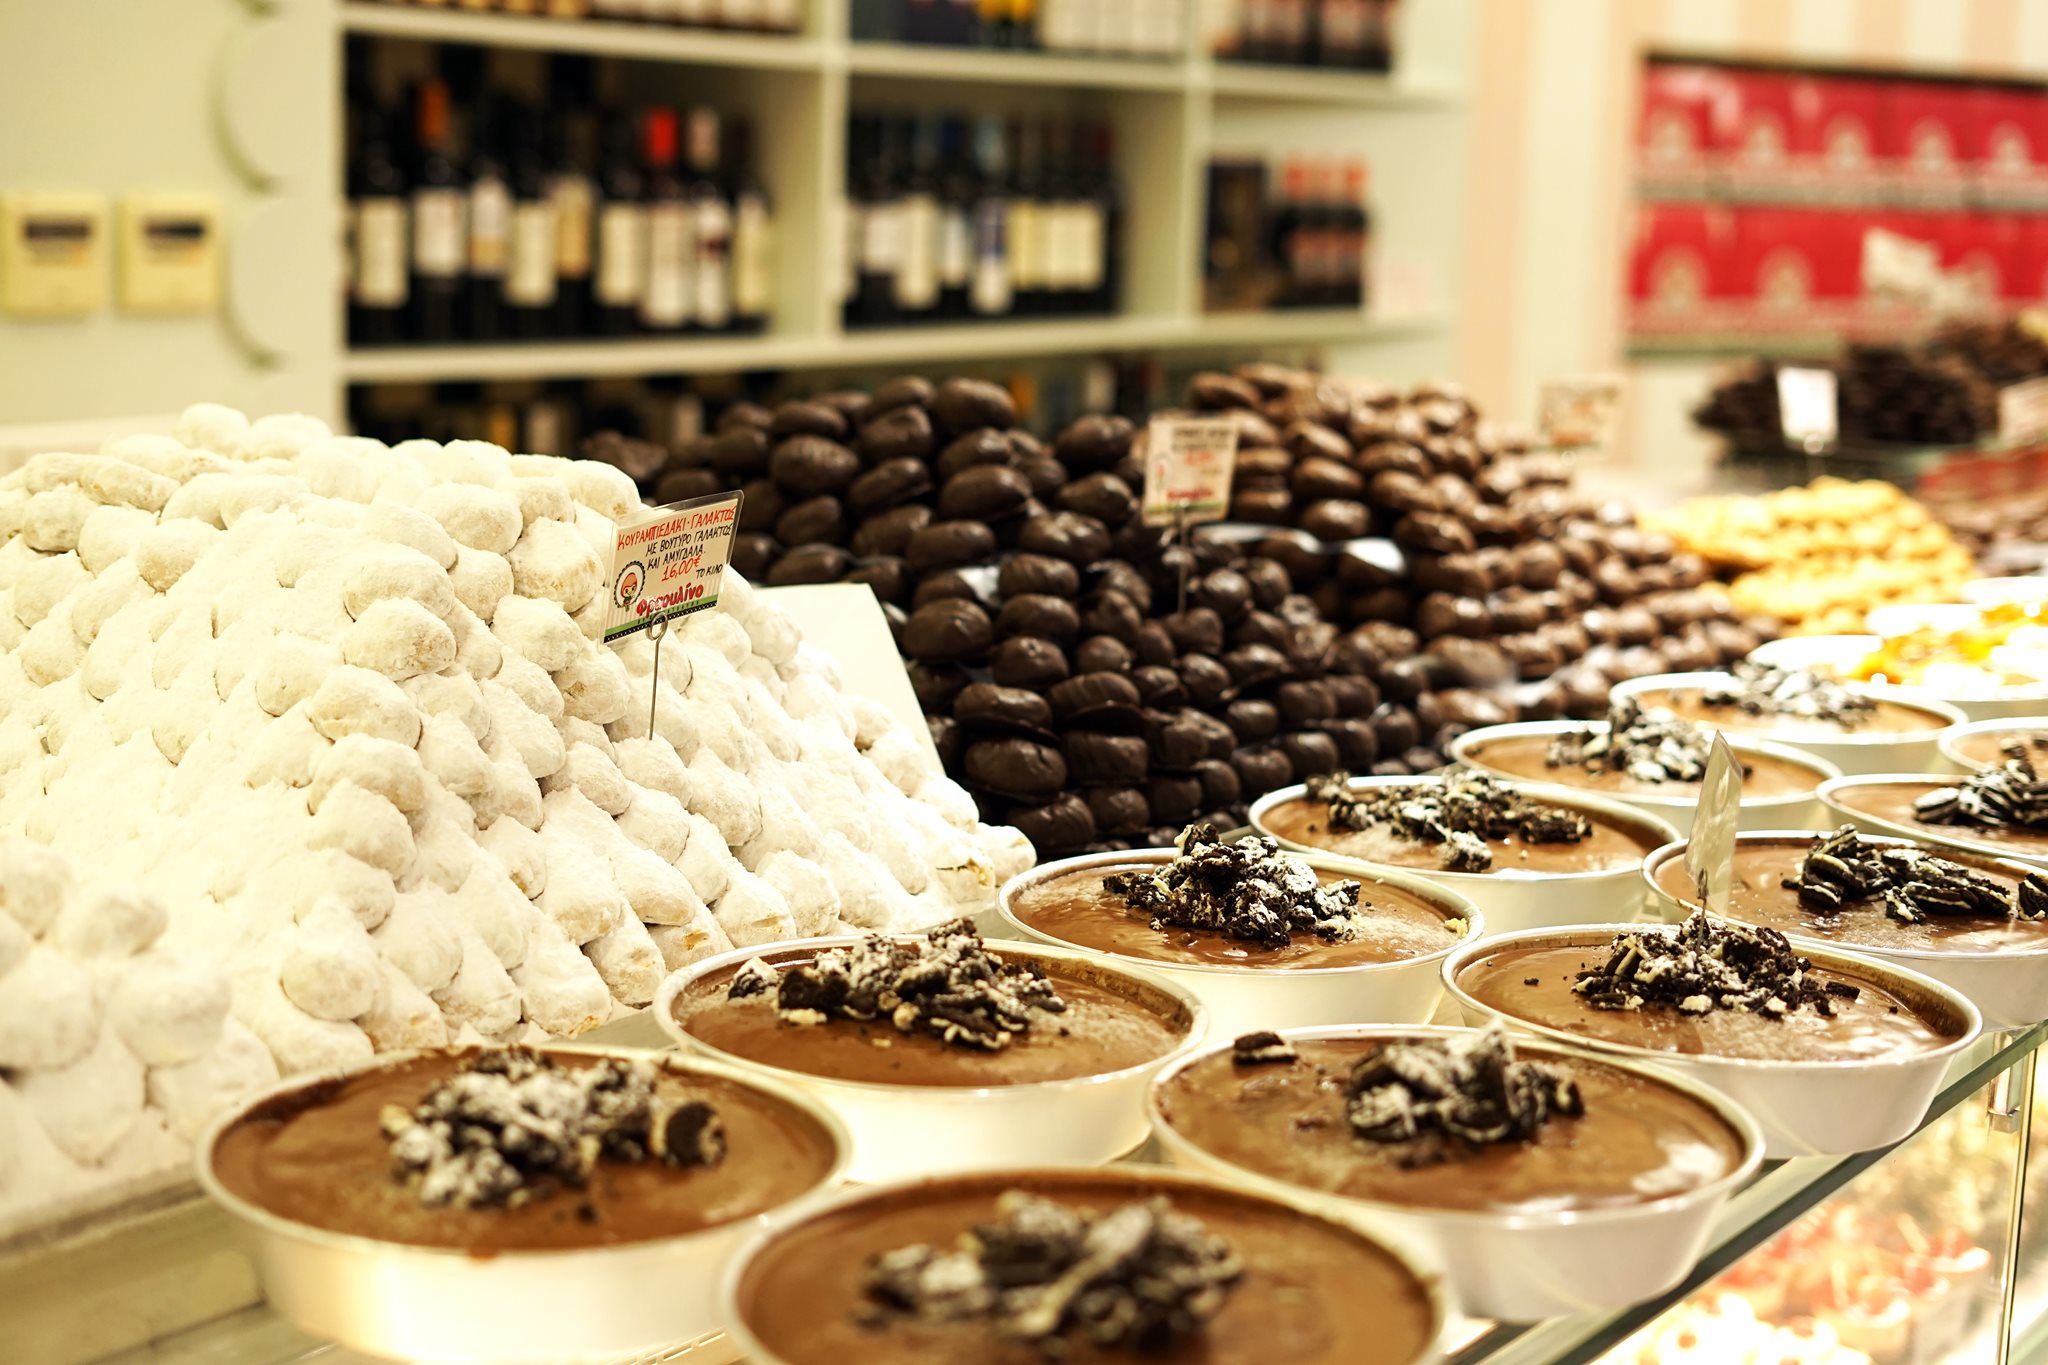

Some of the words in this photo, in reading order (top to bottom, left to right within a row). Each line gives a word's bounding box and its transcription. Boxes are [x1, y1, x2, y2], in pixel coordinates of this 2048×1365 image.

[645, 541, 658, 558] ΜΕ
[660, 533, 691, 553] ΒΟΥΤΥΡΟ
[647, 556, 661, 571] ΚΑΙ
